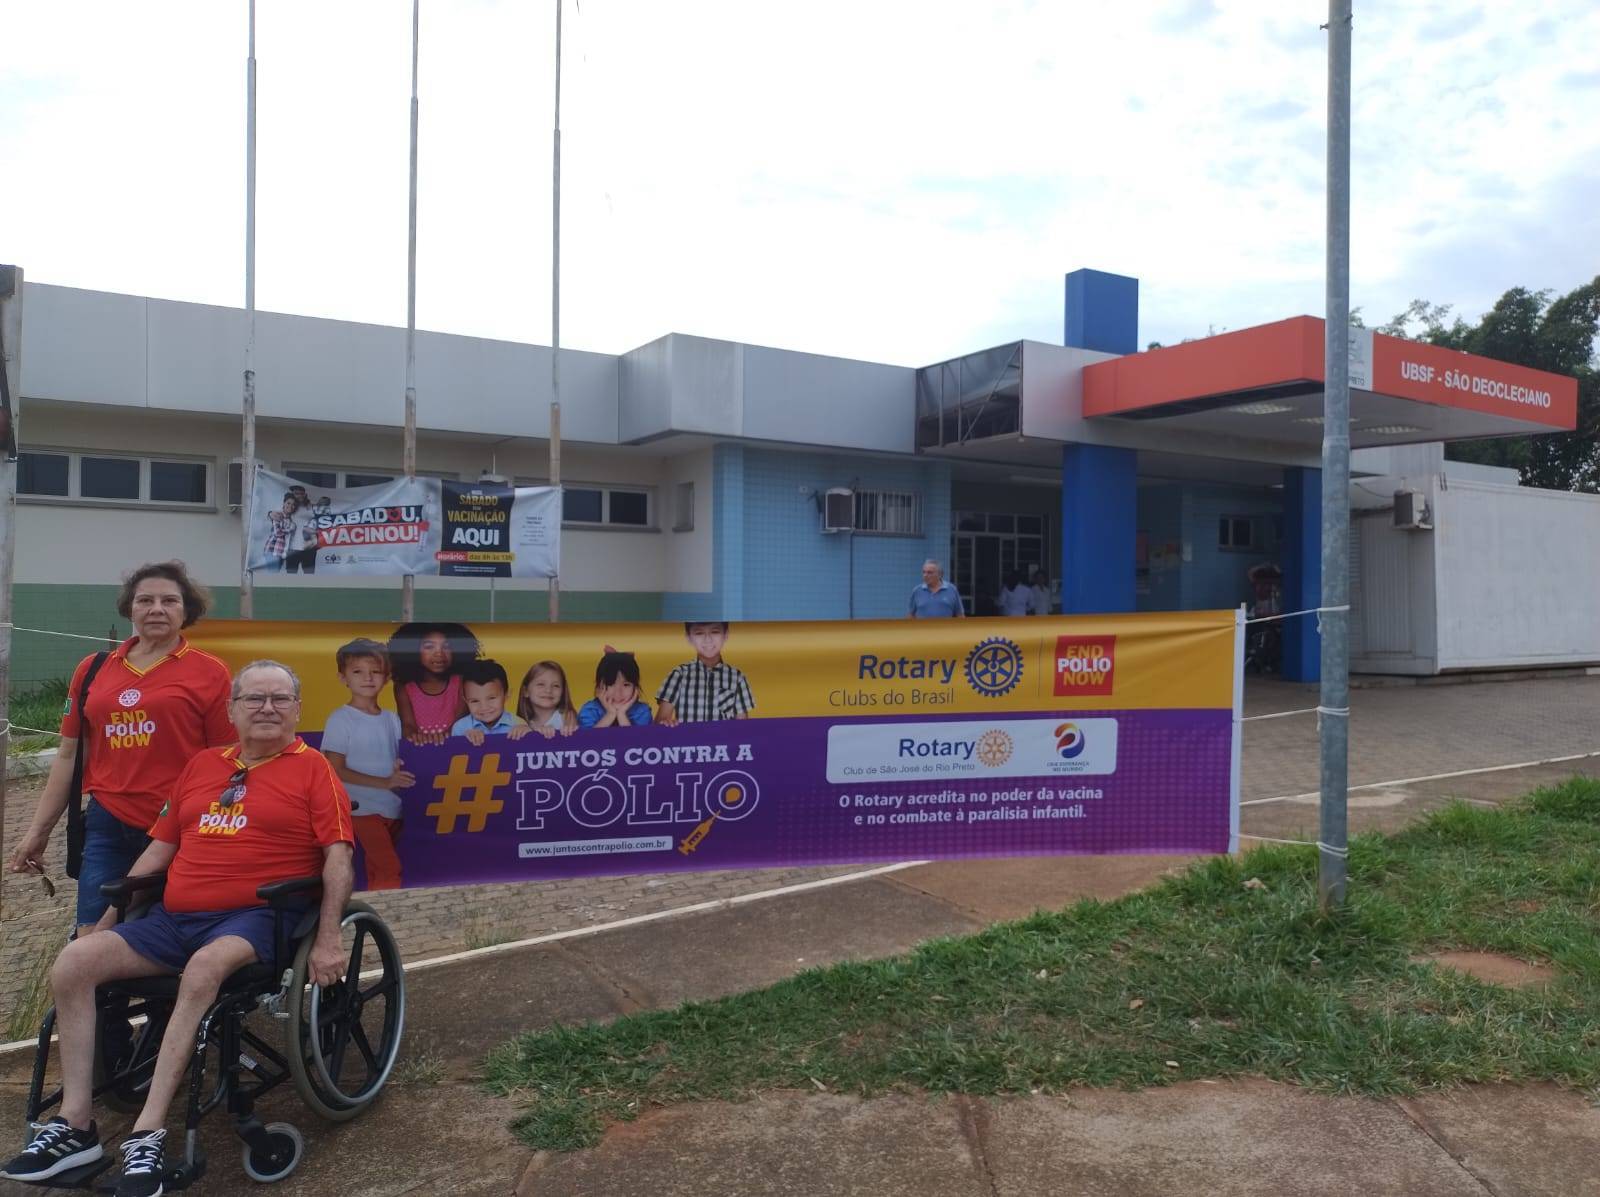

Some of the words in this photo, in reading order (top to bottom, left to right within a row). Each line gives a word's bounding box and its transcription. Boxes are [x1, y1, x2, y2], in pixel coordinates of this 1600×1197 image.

[1401, 361, 1434, 384] UBSF
[1444, 370, 1469, 392] SÃO
[1472, 379, 1551, 408] DEOCLECIANO
[460, 493, 498, 506] SÁBADO
[447, 509, 506, 525] VACINAÇÃO
[321, 525, 418, 544] VACINOU!
[452, 528, 499, 547] AQUI
[1066, 645, 1104, 659] END
[858, 655, 957, 684] Rotary
[1057, 658, 1111, 673] POLIO
[1063, 671, 1106, 686] NOW
[829, 688, 878, 707] Clubs
[883, 688, 905, 706] do
[911, 688, 954, 705] Brasil
[110, 709, 147, 725] END
[105, 720, 156, 738] POLIO
[110, 732, 152, 749] NOW
[898, 738, 976, 761] Rotary
[516, 749, 617, 774] JUNTOS
[624, 745, 729, 766] CONTRA
[736, 744, 754, 761] A
[843, 766, 864, 776] Club
[866, 766, 877, 775] de
[879, 765, 897, 774] São
[899, 764, 920, 773] José
[922, 764, 934, 773] do
[935, 763, 950, 772] Rio
[952, 762, 975, 771] Preto
[516, 769, 760, 830] PÓLIO
[839, 795, 850, 808] O
[854, 794, 904, 809] Rotary
[907, 790, 966, 805] acredita
[970, 792, 987, 803] no
[991, 788, 1033, 805] poder
[1036, 787, 1054, 801] da
[1058, 786, 1103, 800] vacina
[199, 814, 248, 829] POLIO
[854, 815, 863, 825] e
[867, 814, 885, 825] no
[889, 809, 952, 824] combate
[956, 808, 964, 822] à
[968, 806, 1029, 824] paralisia
[1032, 804, 1087, 819] infantil.
[525, 838, 667, 857] www.juntoscontrapolio.com.br
